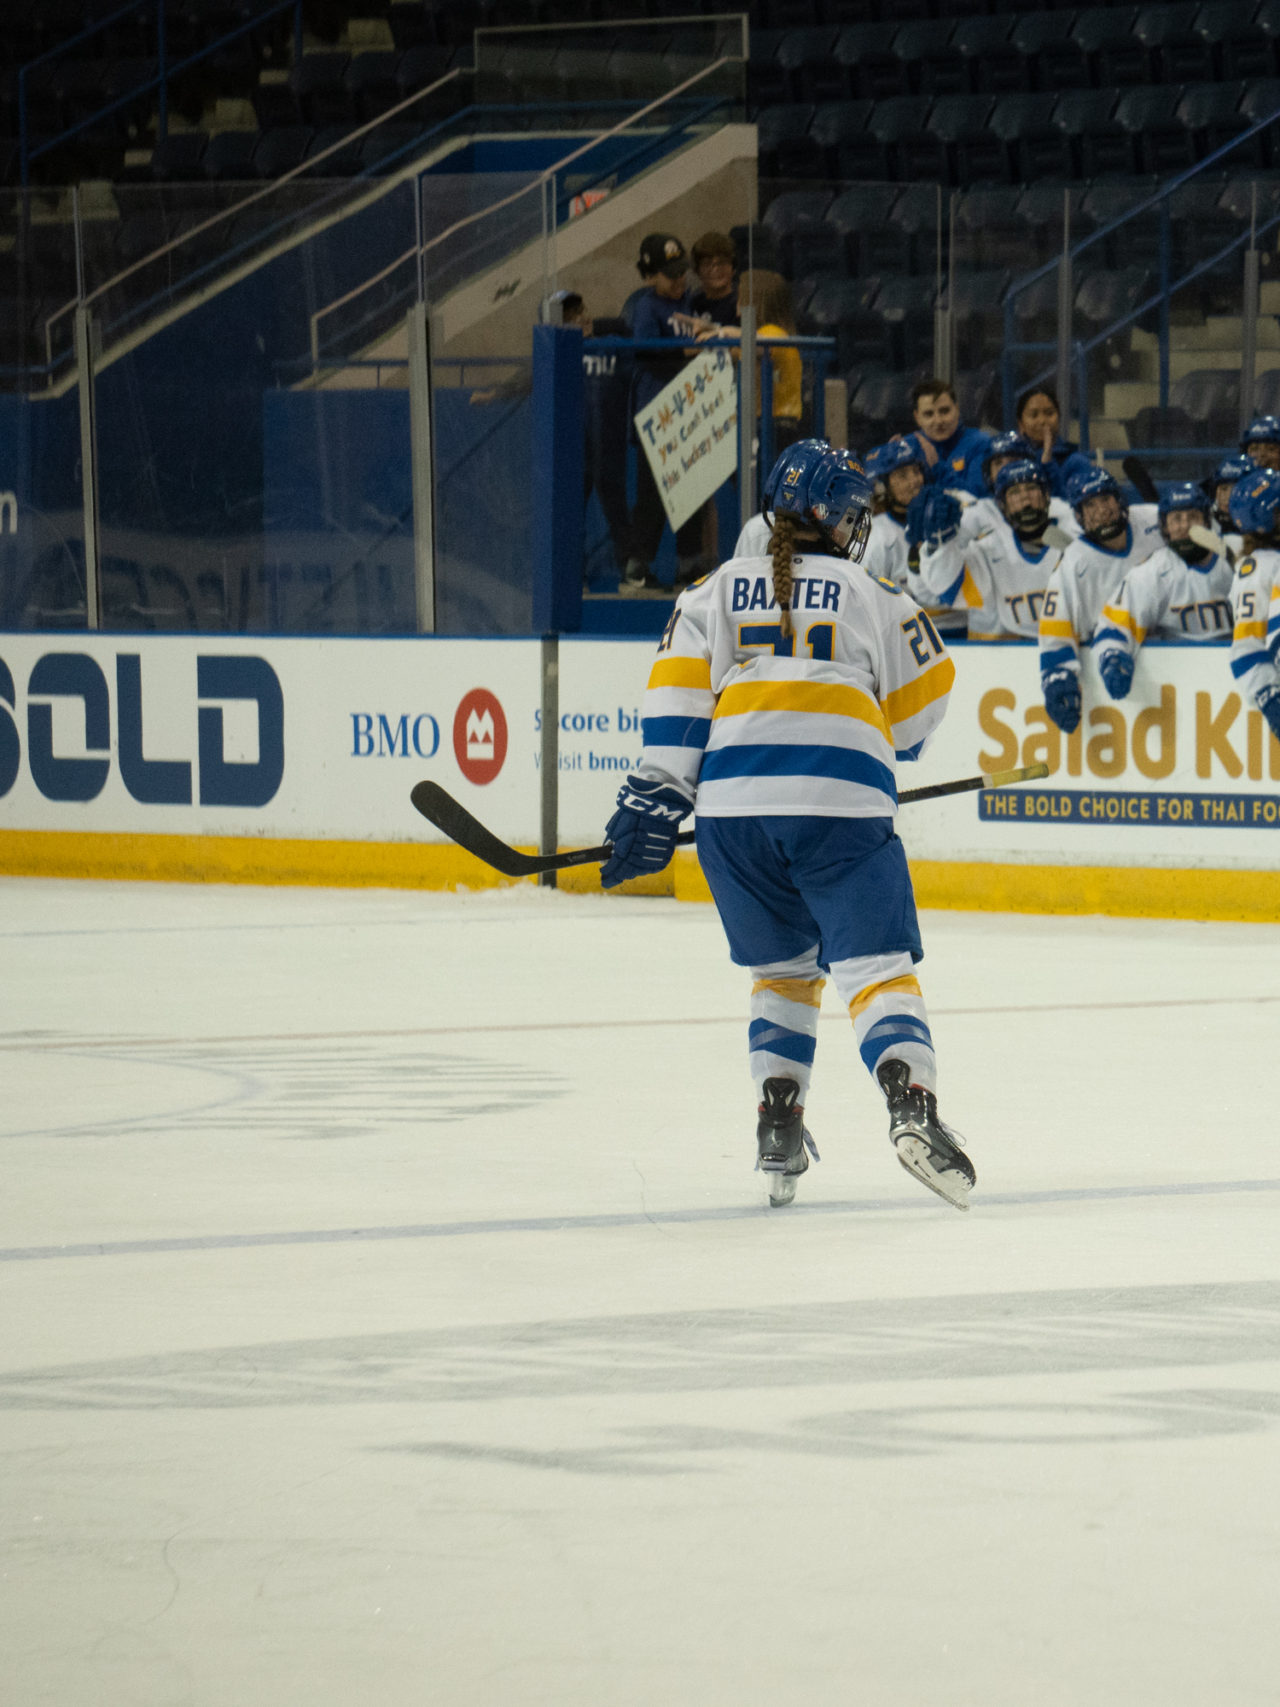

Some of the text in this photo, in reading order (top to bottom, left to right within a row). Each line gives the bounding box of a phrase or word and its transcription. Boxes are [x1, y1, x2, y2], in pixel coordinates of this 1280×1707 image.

[902, 610, 945, 667] 21
[0, 652, 285, 808] OLD
[349, 711, 441, 758] BMO
[618, 707, 643, 737] bi
[978, 684, 1176, 779] Salad
[984, 795, 1018, 816] THE
[1025, 796, 1072, 817] BOLD
[1079, 797, 1150, 819] CHOICE
[1157, 799, 1194, 820] FOR
[1201, 800, 1245, 821] THAI
